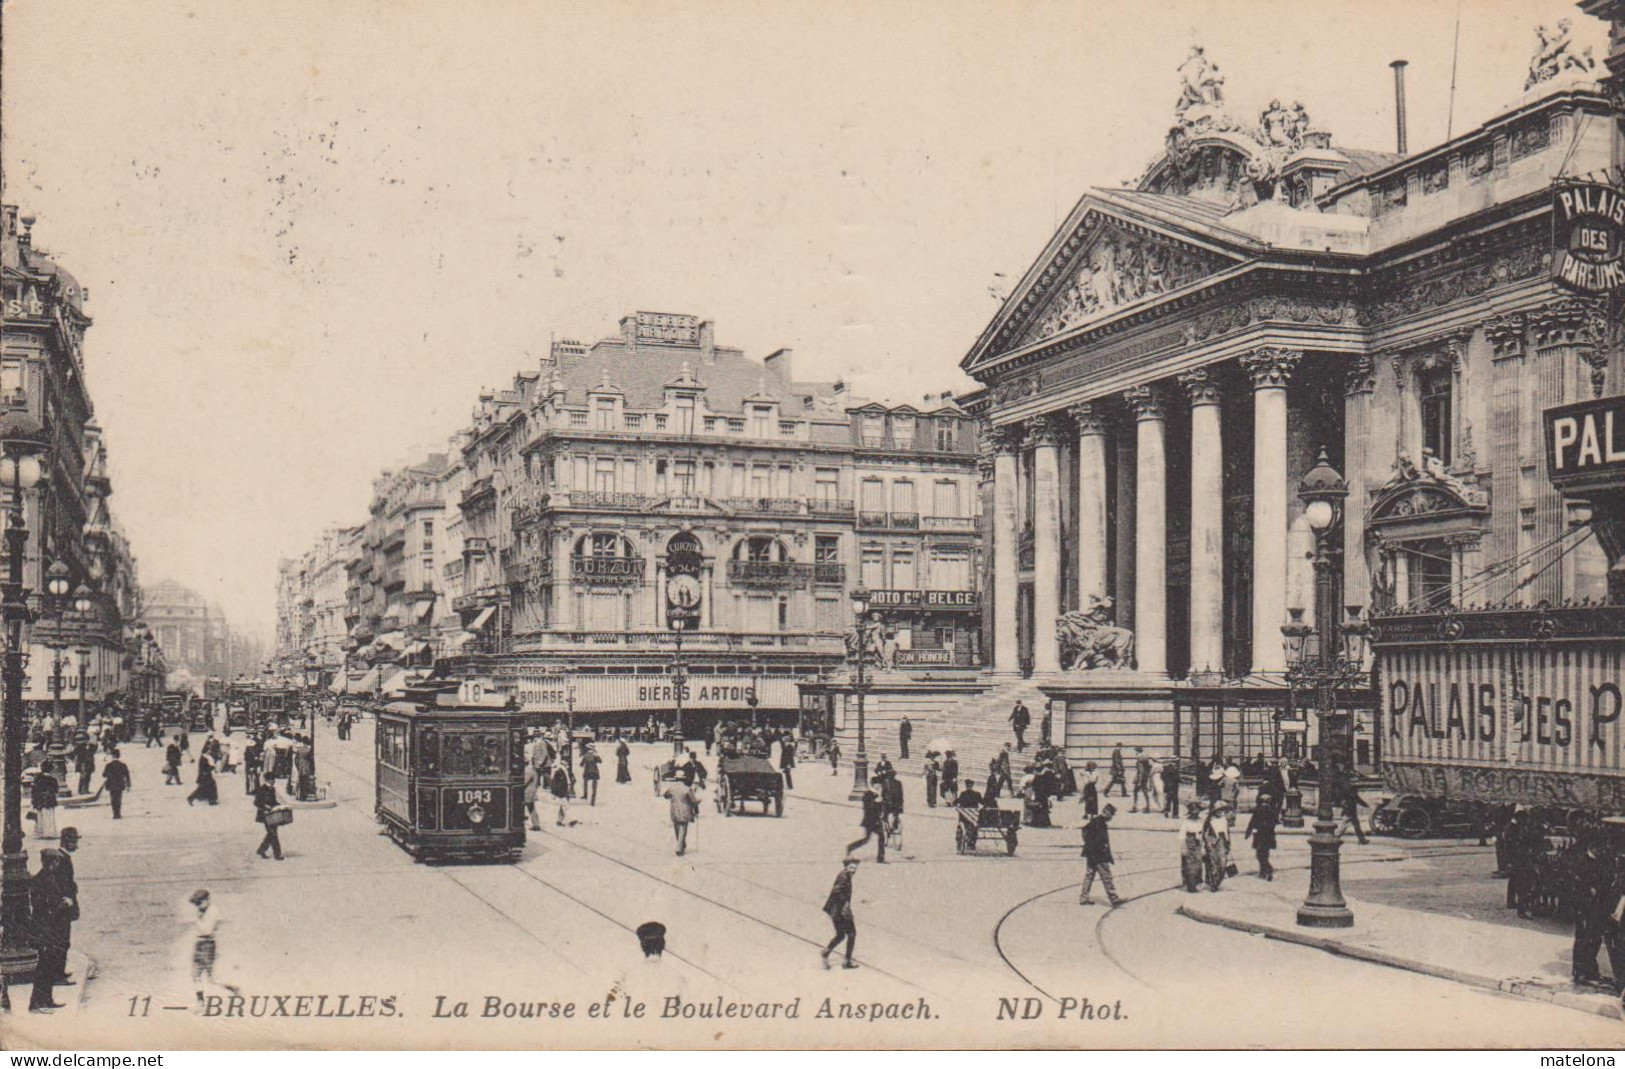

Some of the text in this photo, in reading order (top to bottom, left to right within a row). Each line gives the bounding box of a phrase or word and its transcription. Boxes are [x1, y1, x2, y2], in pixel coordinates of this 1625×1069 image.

[1560, 187, 1625, 225] PALAIS
[1582, 228, 1608, 251] DES
[1554, 410, 1625, 470] PAL
[929, 592, 973, 605] BELGE
[463, 683, 482, 704] 18
[520, 690, 564, 704] BOURSE
[699, 685, 756, 701] ARTOIS
[1389, 679, 1496, 742] PALAIS
